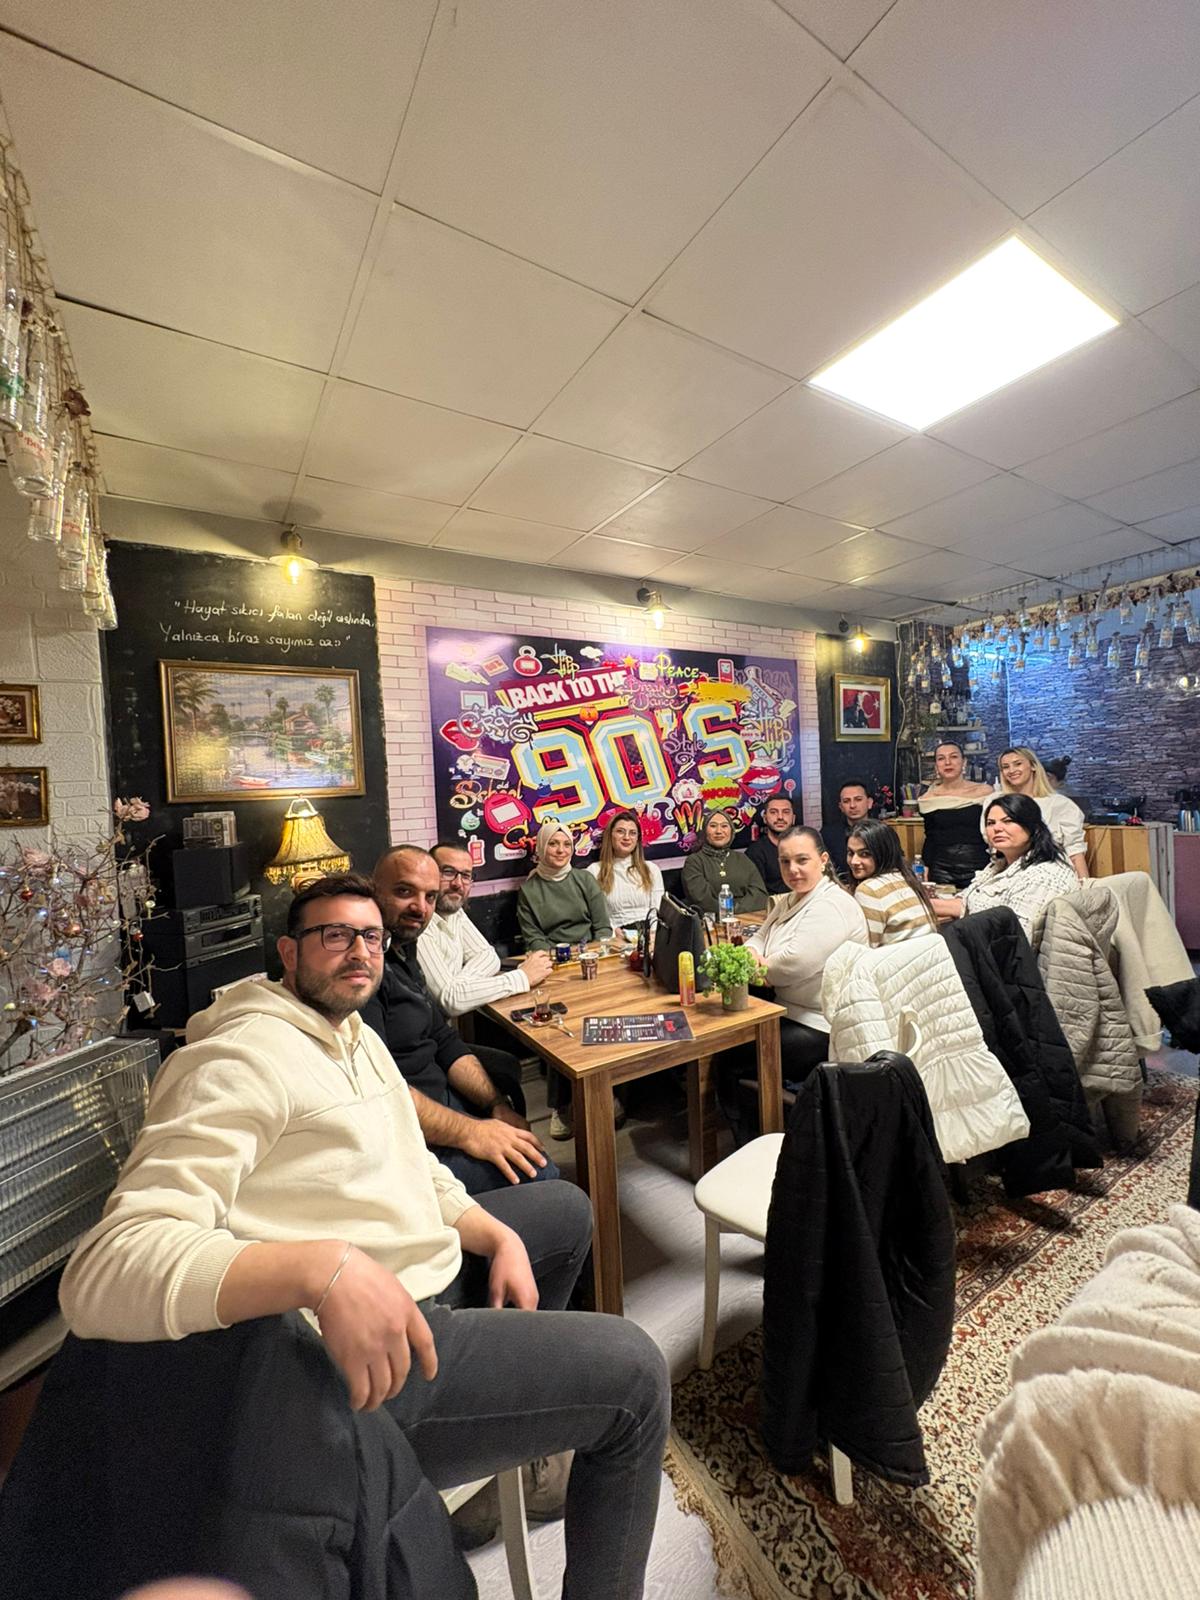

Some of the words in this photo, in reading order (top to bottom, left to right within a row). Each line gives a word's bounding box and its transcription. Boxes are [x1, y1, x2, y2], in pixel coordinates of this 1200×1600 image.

[267, 604, 303, 623] falan
[228, 627, 260, 644] biraz
[265, 635, 315, 653] sayımız
[507, 680, 569, 708] BACK
[566, 675, 596, 699] TO
[591, 669, 628, 695] THE
